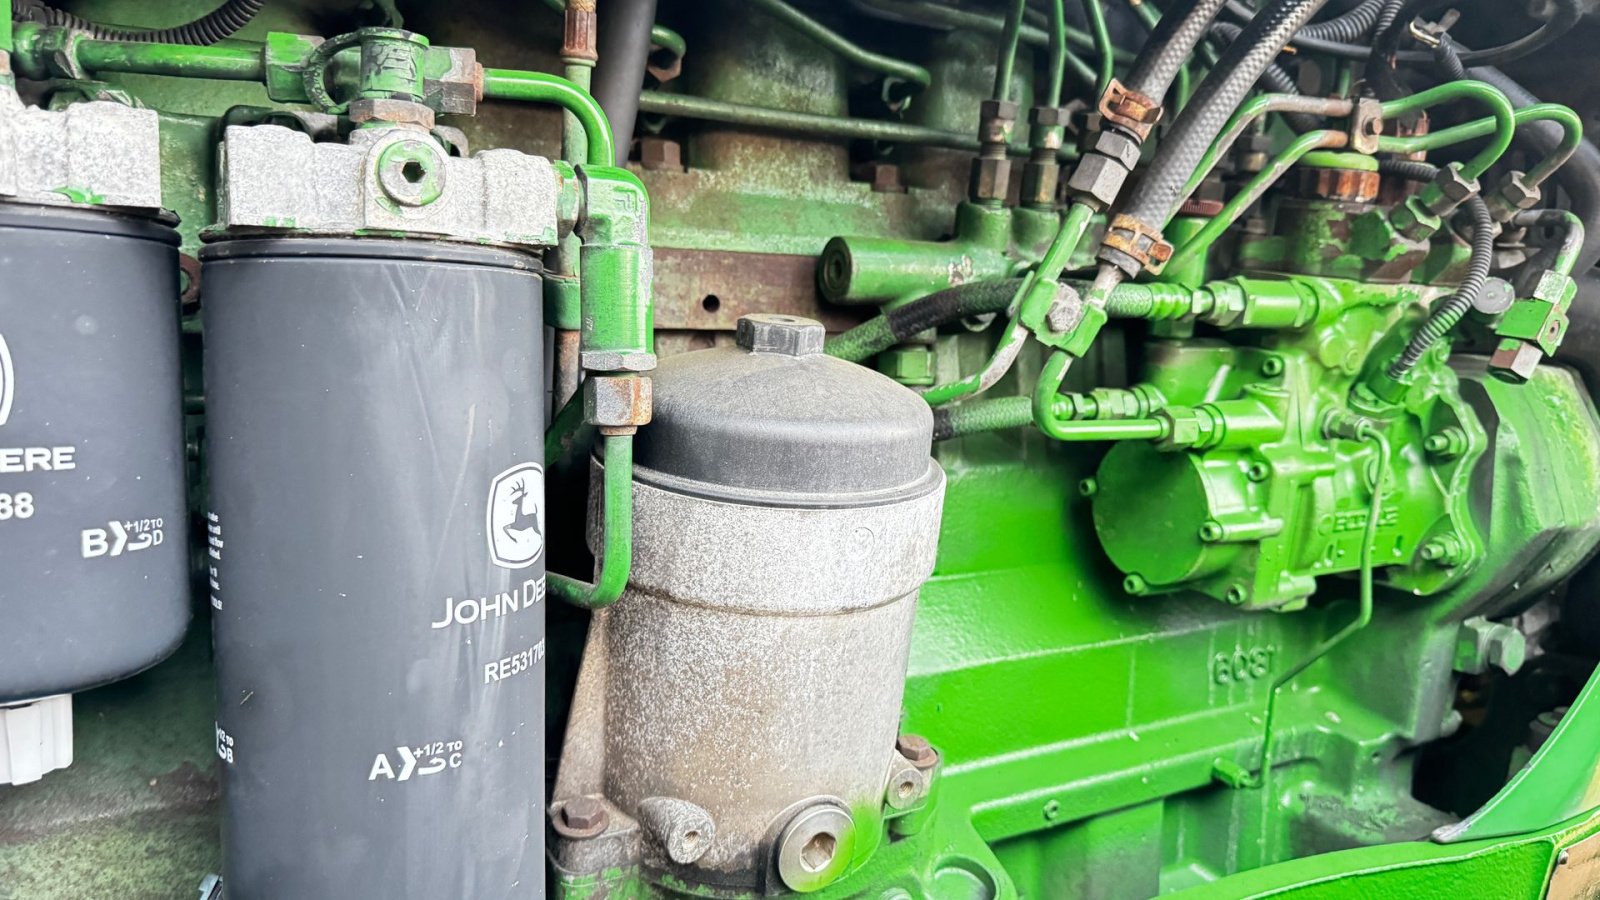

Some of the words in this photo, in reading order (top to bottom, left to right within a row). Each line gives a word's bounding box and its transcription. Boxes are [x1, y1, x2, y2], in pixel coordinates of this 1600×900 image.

[0, 446, 76, 473] ERE
[82, 528, 108, 558] B
[124, 519, 149, 533] +1/2
[150, 518, 164, 530] TO
[152, 530, 164, 545] D
[431, 589, 518, 629] JOHN
[368, 753, 395, 780] A
[413, 742, 444, 758] +1/2
[446, 740, 463, 752] TO
[449, 753, 462, 768] C
